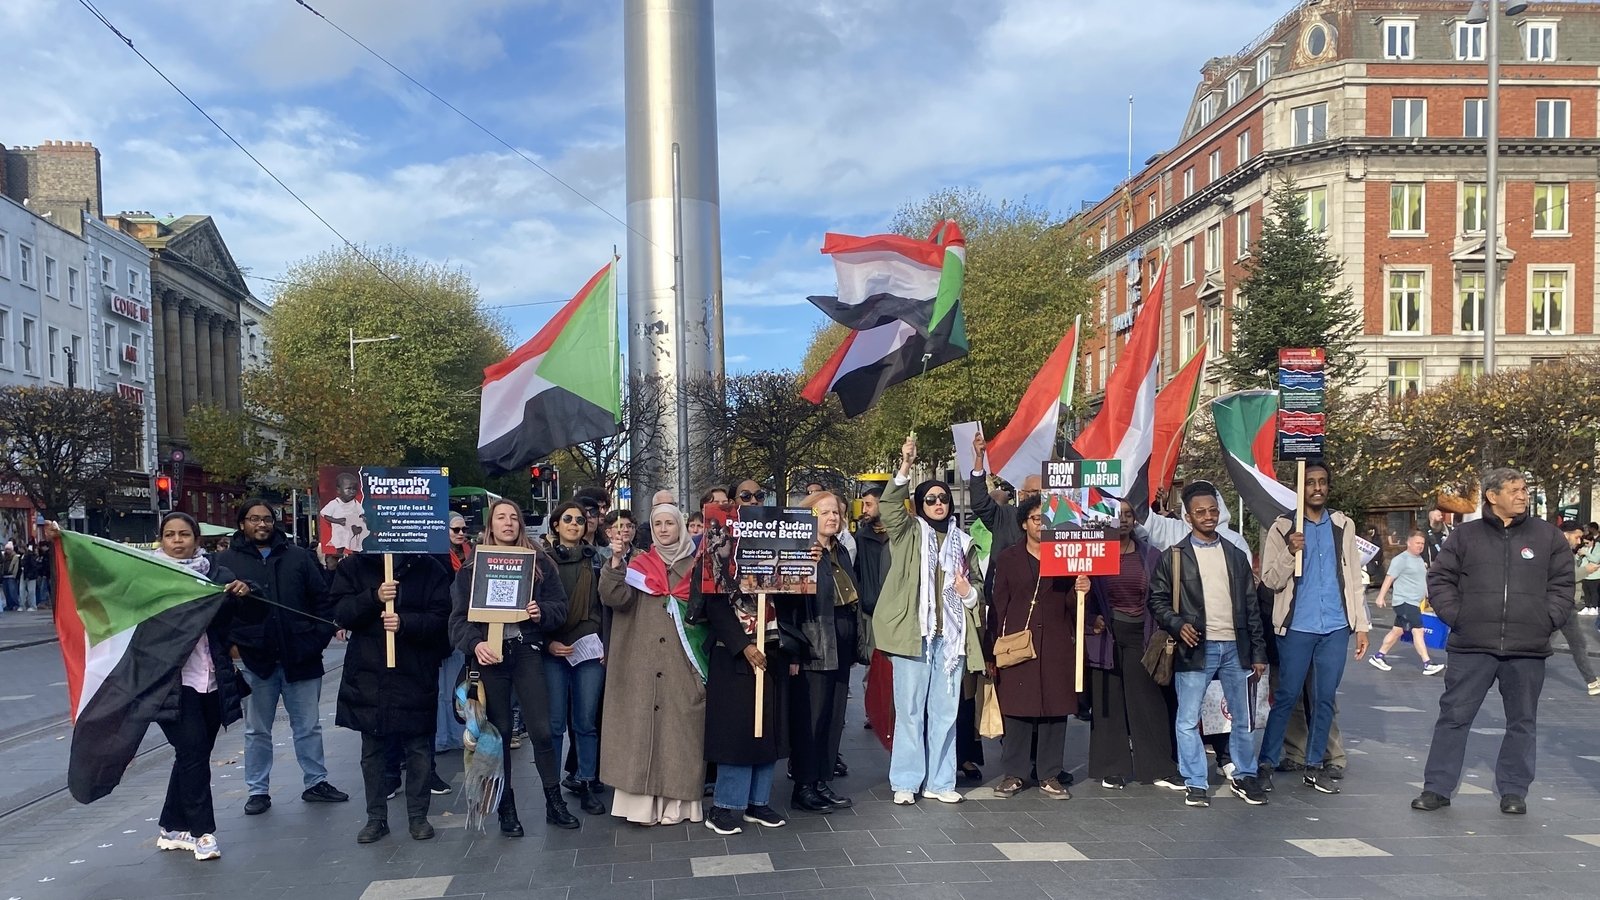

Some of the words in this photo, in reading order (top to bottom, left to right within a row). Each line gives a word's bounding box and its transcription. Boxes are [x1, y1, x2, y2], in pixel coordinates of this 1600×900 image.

[114, 296, 138, 319] COME
[119, 383, 144, 404] VISIT
[1048, 462, 1074, 474] FROM
[1096, 462, 1107, 473] TO
[368, 476, 430, 487] Humanity
[1049, 475, 1072, 486] GAZA
[1084, 474, 1119, 486] DARFUR
[370, 486, 388, 494] for
[391, 486, 430, 494] Sudan
[726, 519, 763, 530] People
[766, 520, 777, 529] of
[779, 521, 812, 530] Sudan
[733, 529, 776, 538] Deserve
[779, 530, 812, 539] Better
[1055, 531, 1069, 540] STOP
[1070, 531, 1081, 540] THE
[1081, 531, 1104, 540] KILLING
[1055, 544, 1082, 558] STOP
[1086, 543, 1106, 557] THE
[1067, 558, 1092, 572] WAR
